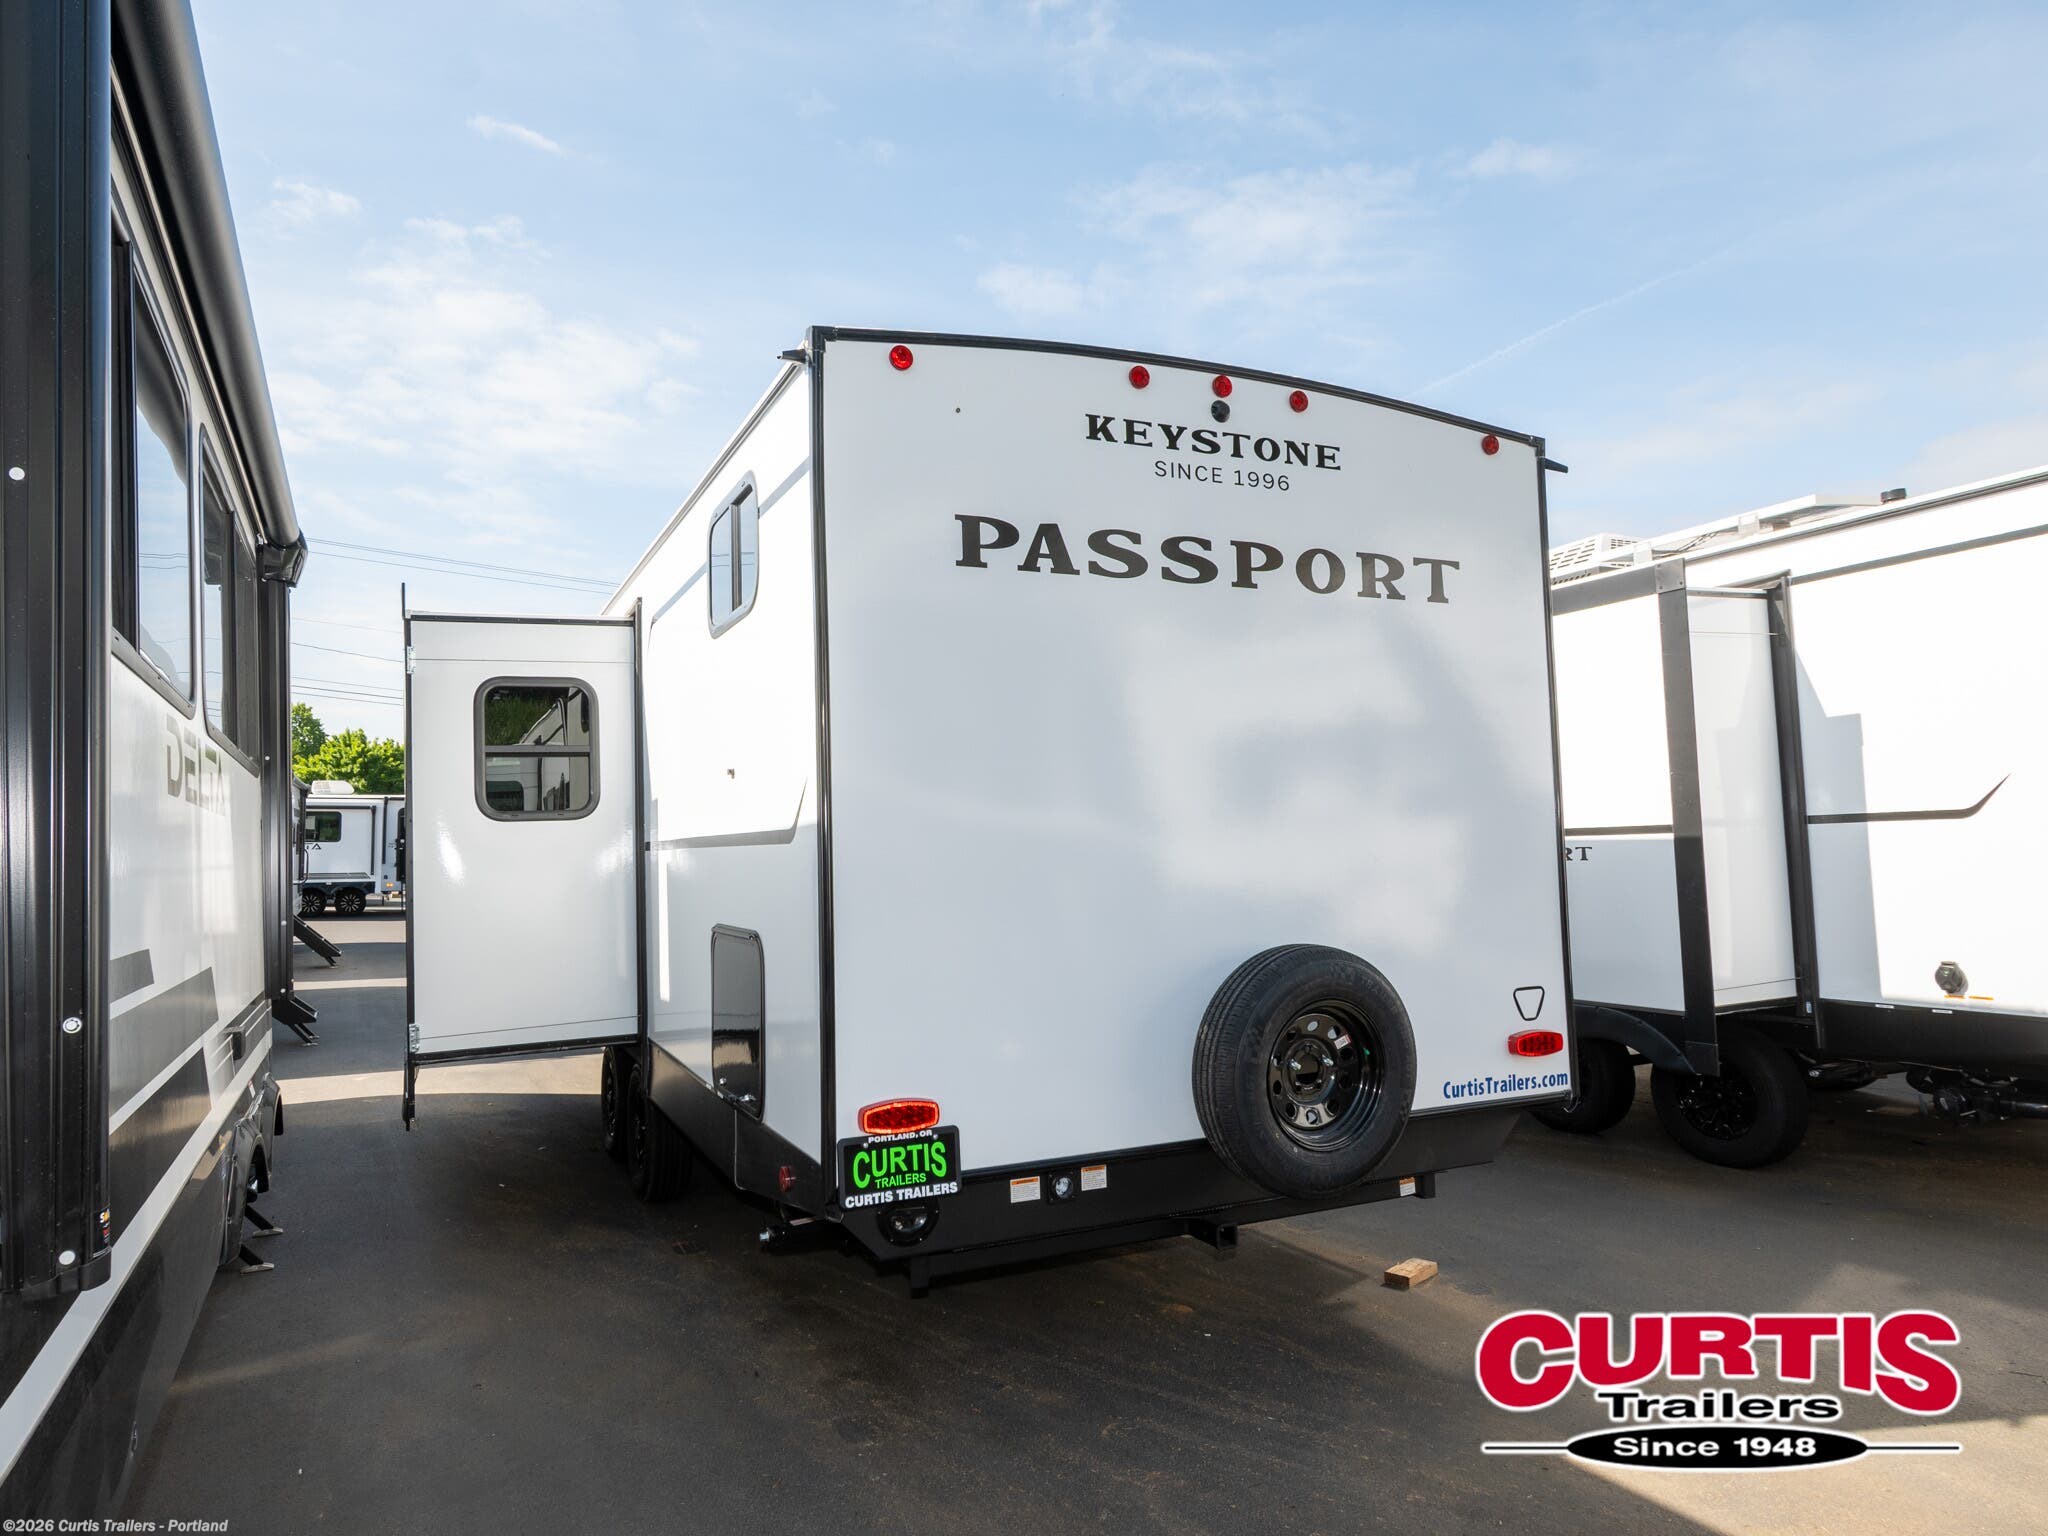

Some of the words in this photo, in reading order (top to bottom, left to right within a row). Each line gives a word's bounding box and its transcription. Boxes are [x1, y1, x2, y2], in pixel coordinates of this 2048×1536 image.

[1085, 413, 1341, 471] KEYSTONE
[1154, 460, 1223, 484] SINCE
[1233, 469, 1290, 491] 1996
[954, 513, 1460, 604] PASSPORT
[1443, 1072, 1568, 1099] CurtisTrailers.com
[868, 1131, 919, 1144] PORTLAND,
[919, 1129, 933, 1138] OR
[853, 1141, 947, 1189] CURTIS
[845, 1190, 894, 1209] CURTIS
[896, 1181, 958, 1201] TRAILERS
[875, 1172, 927, 1189] TRAILERS
